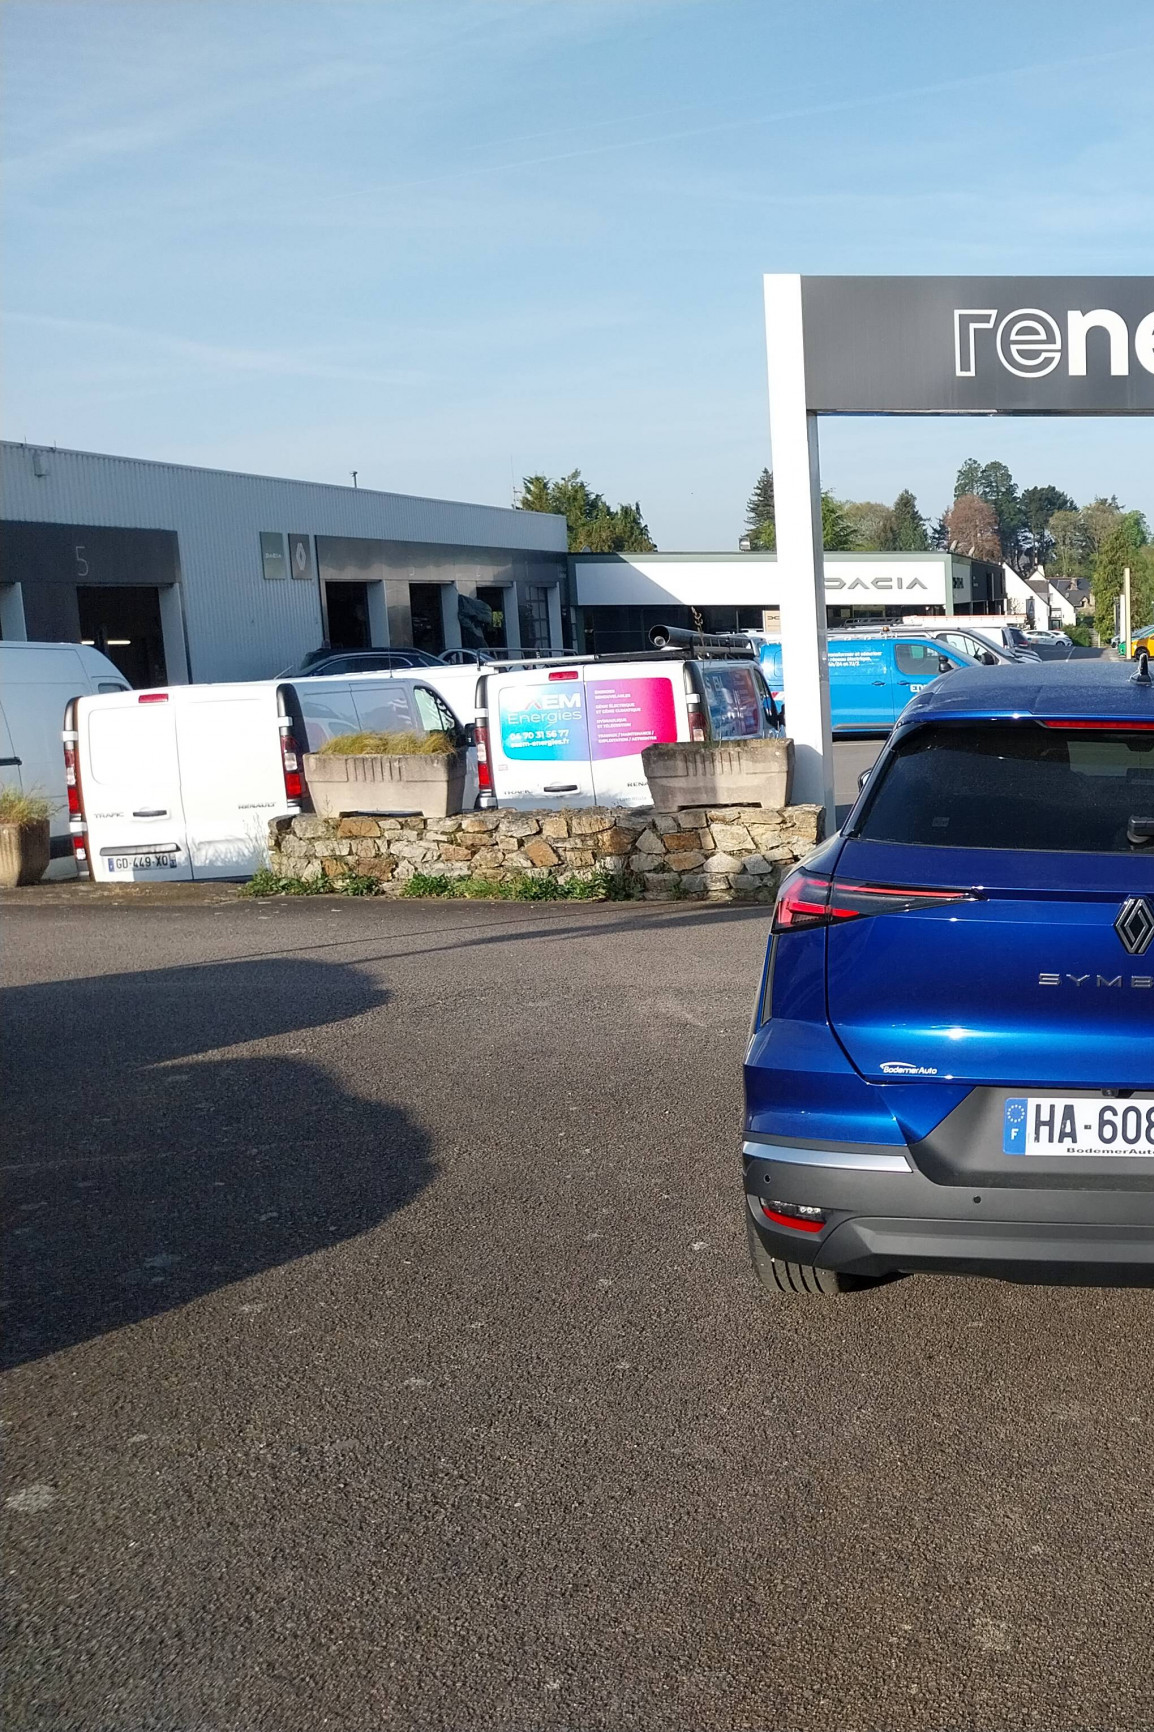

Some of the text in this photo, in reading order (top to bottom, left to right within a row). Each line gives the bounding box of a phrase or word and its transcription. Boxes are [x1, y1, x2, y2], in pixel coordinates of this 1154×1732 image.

[75, 545, 89, 577] 5
[824, 577, 928, 590] DACIA
[507, 710, 582, 725] Energies
[237, 801, 277, 810] RENAULT
[882, 1065, 938, 1075] BodemerAuto
[1010, 1128, 1019, 1140] F
